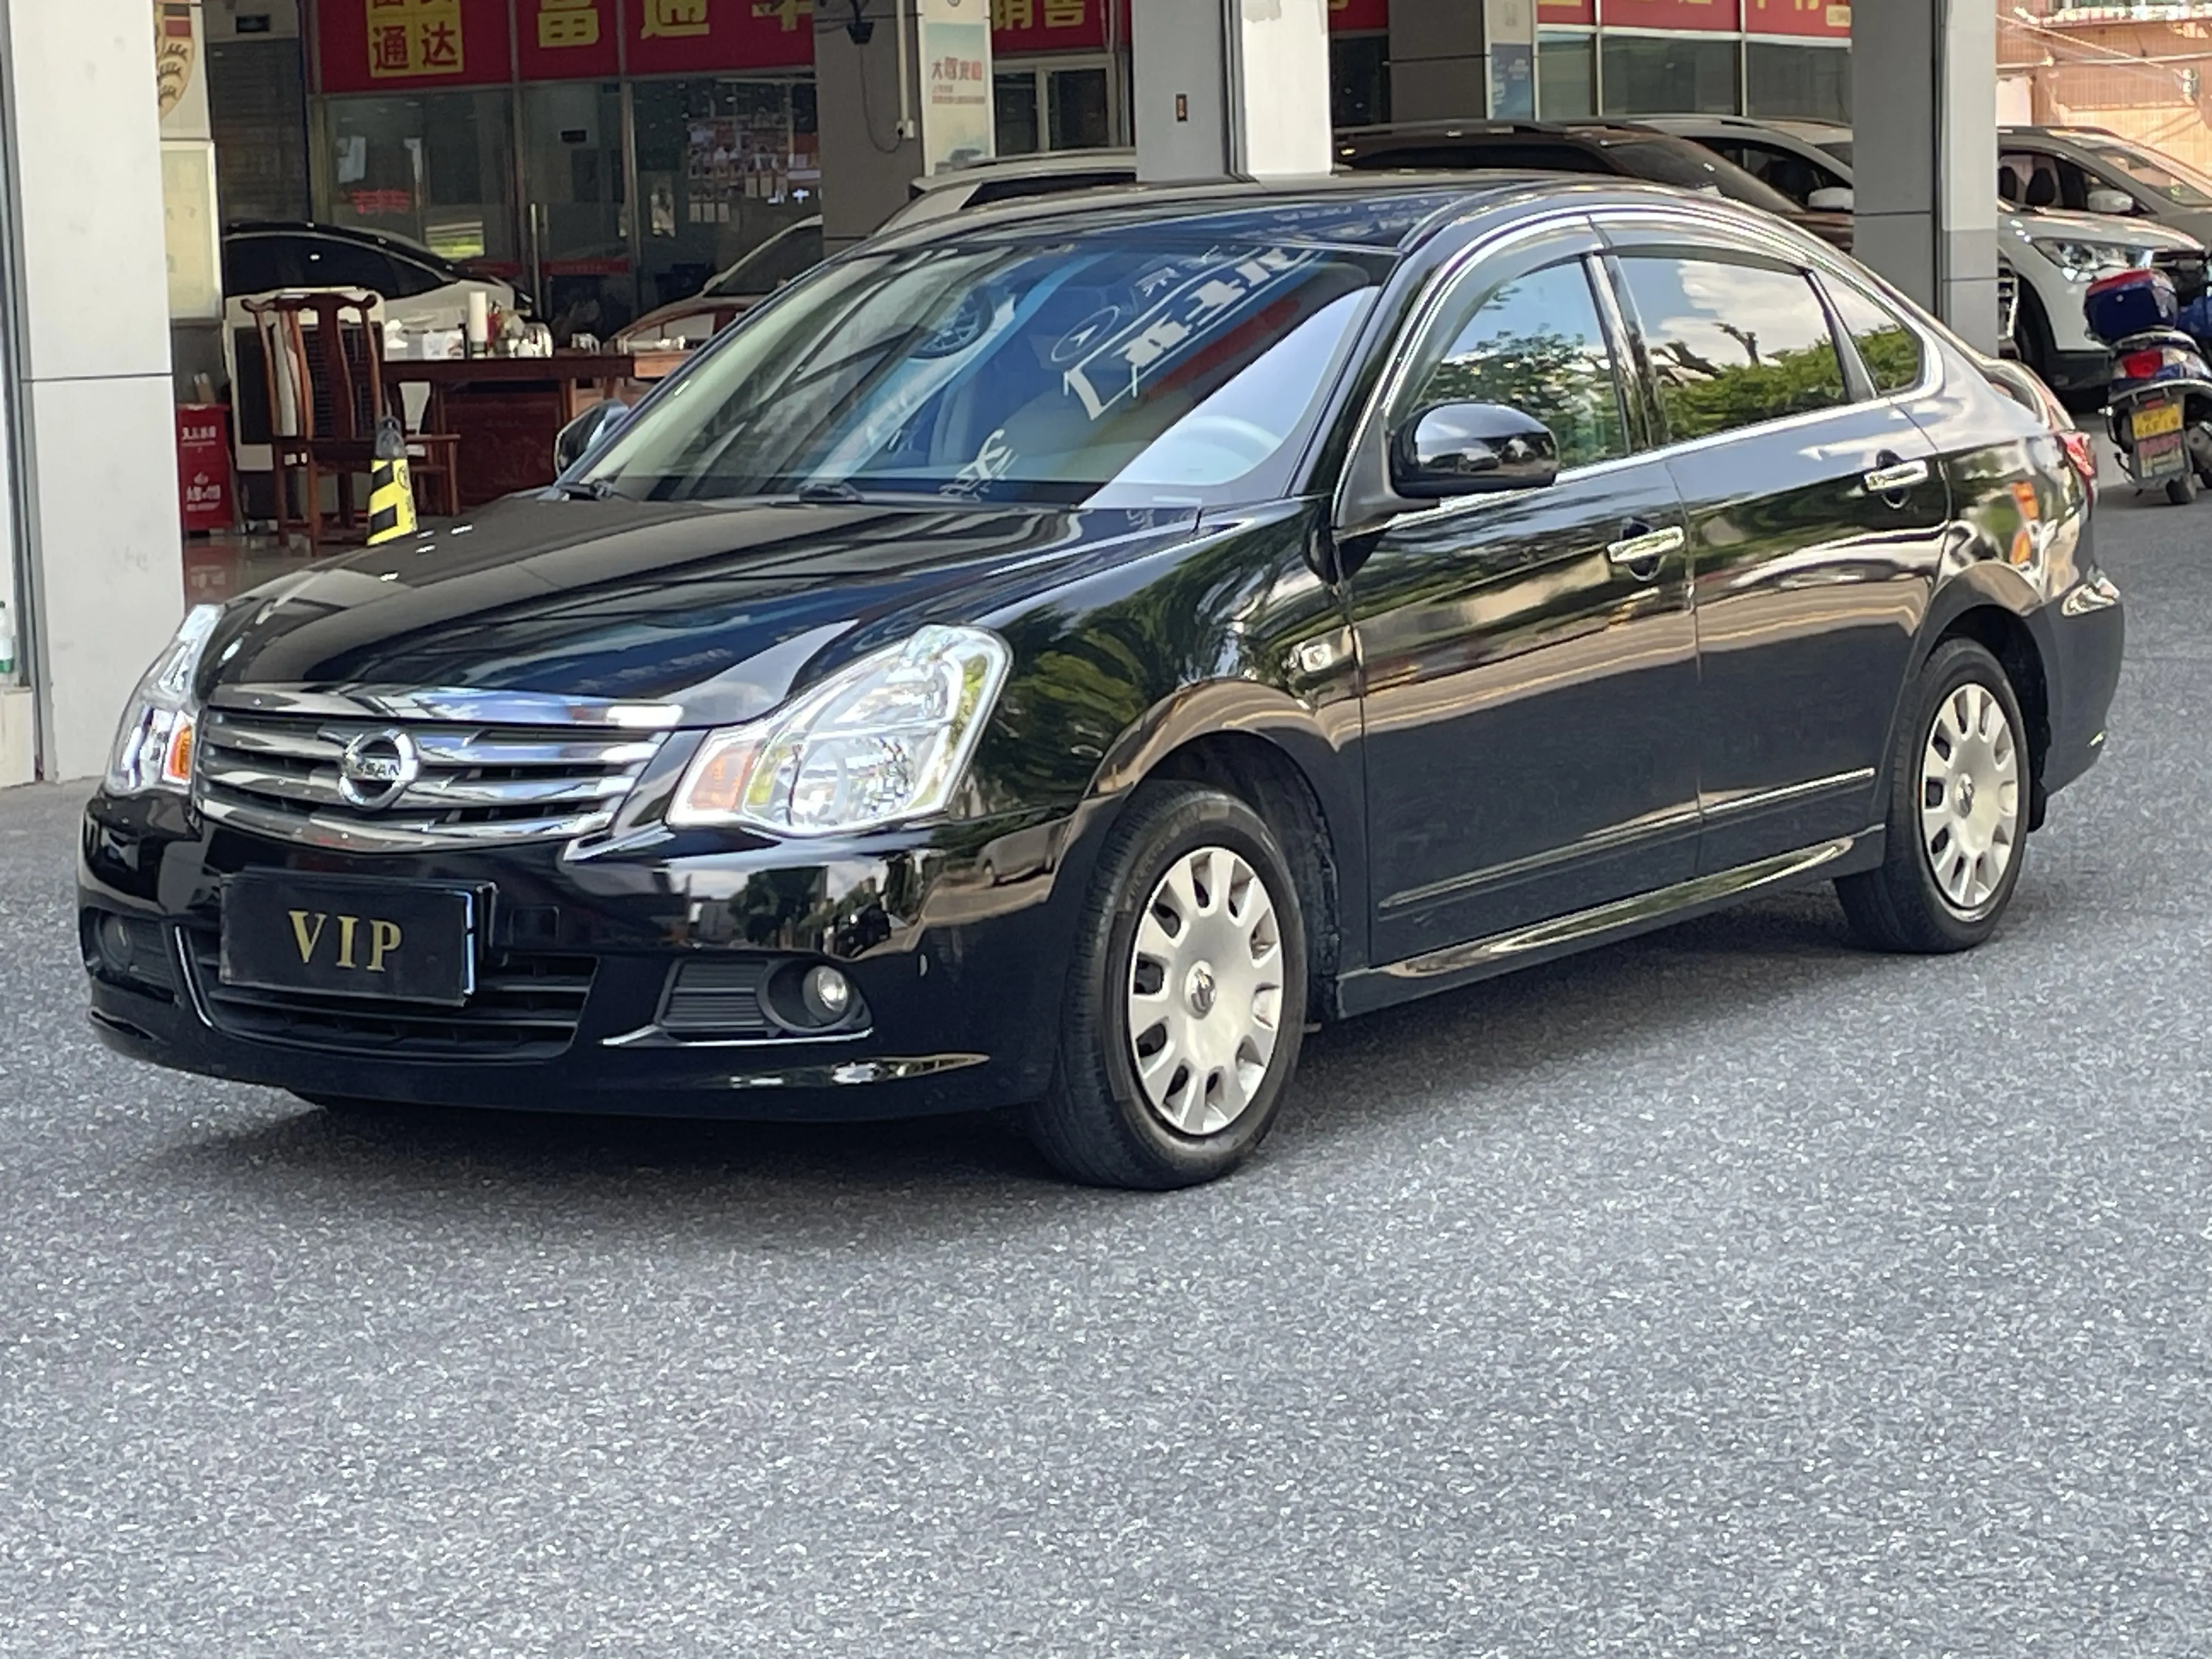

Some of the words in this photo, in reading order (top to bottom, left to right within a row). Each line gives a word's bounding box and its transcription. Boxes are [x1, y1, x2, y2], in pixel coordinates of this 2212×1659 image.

[372, 20, 458, 70] 通达
[346, 762, 399, 778] SSAN
[287, 910, 403, 973] VIP
